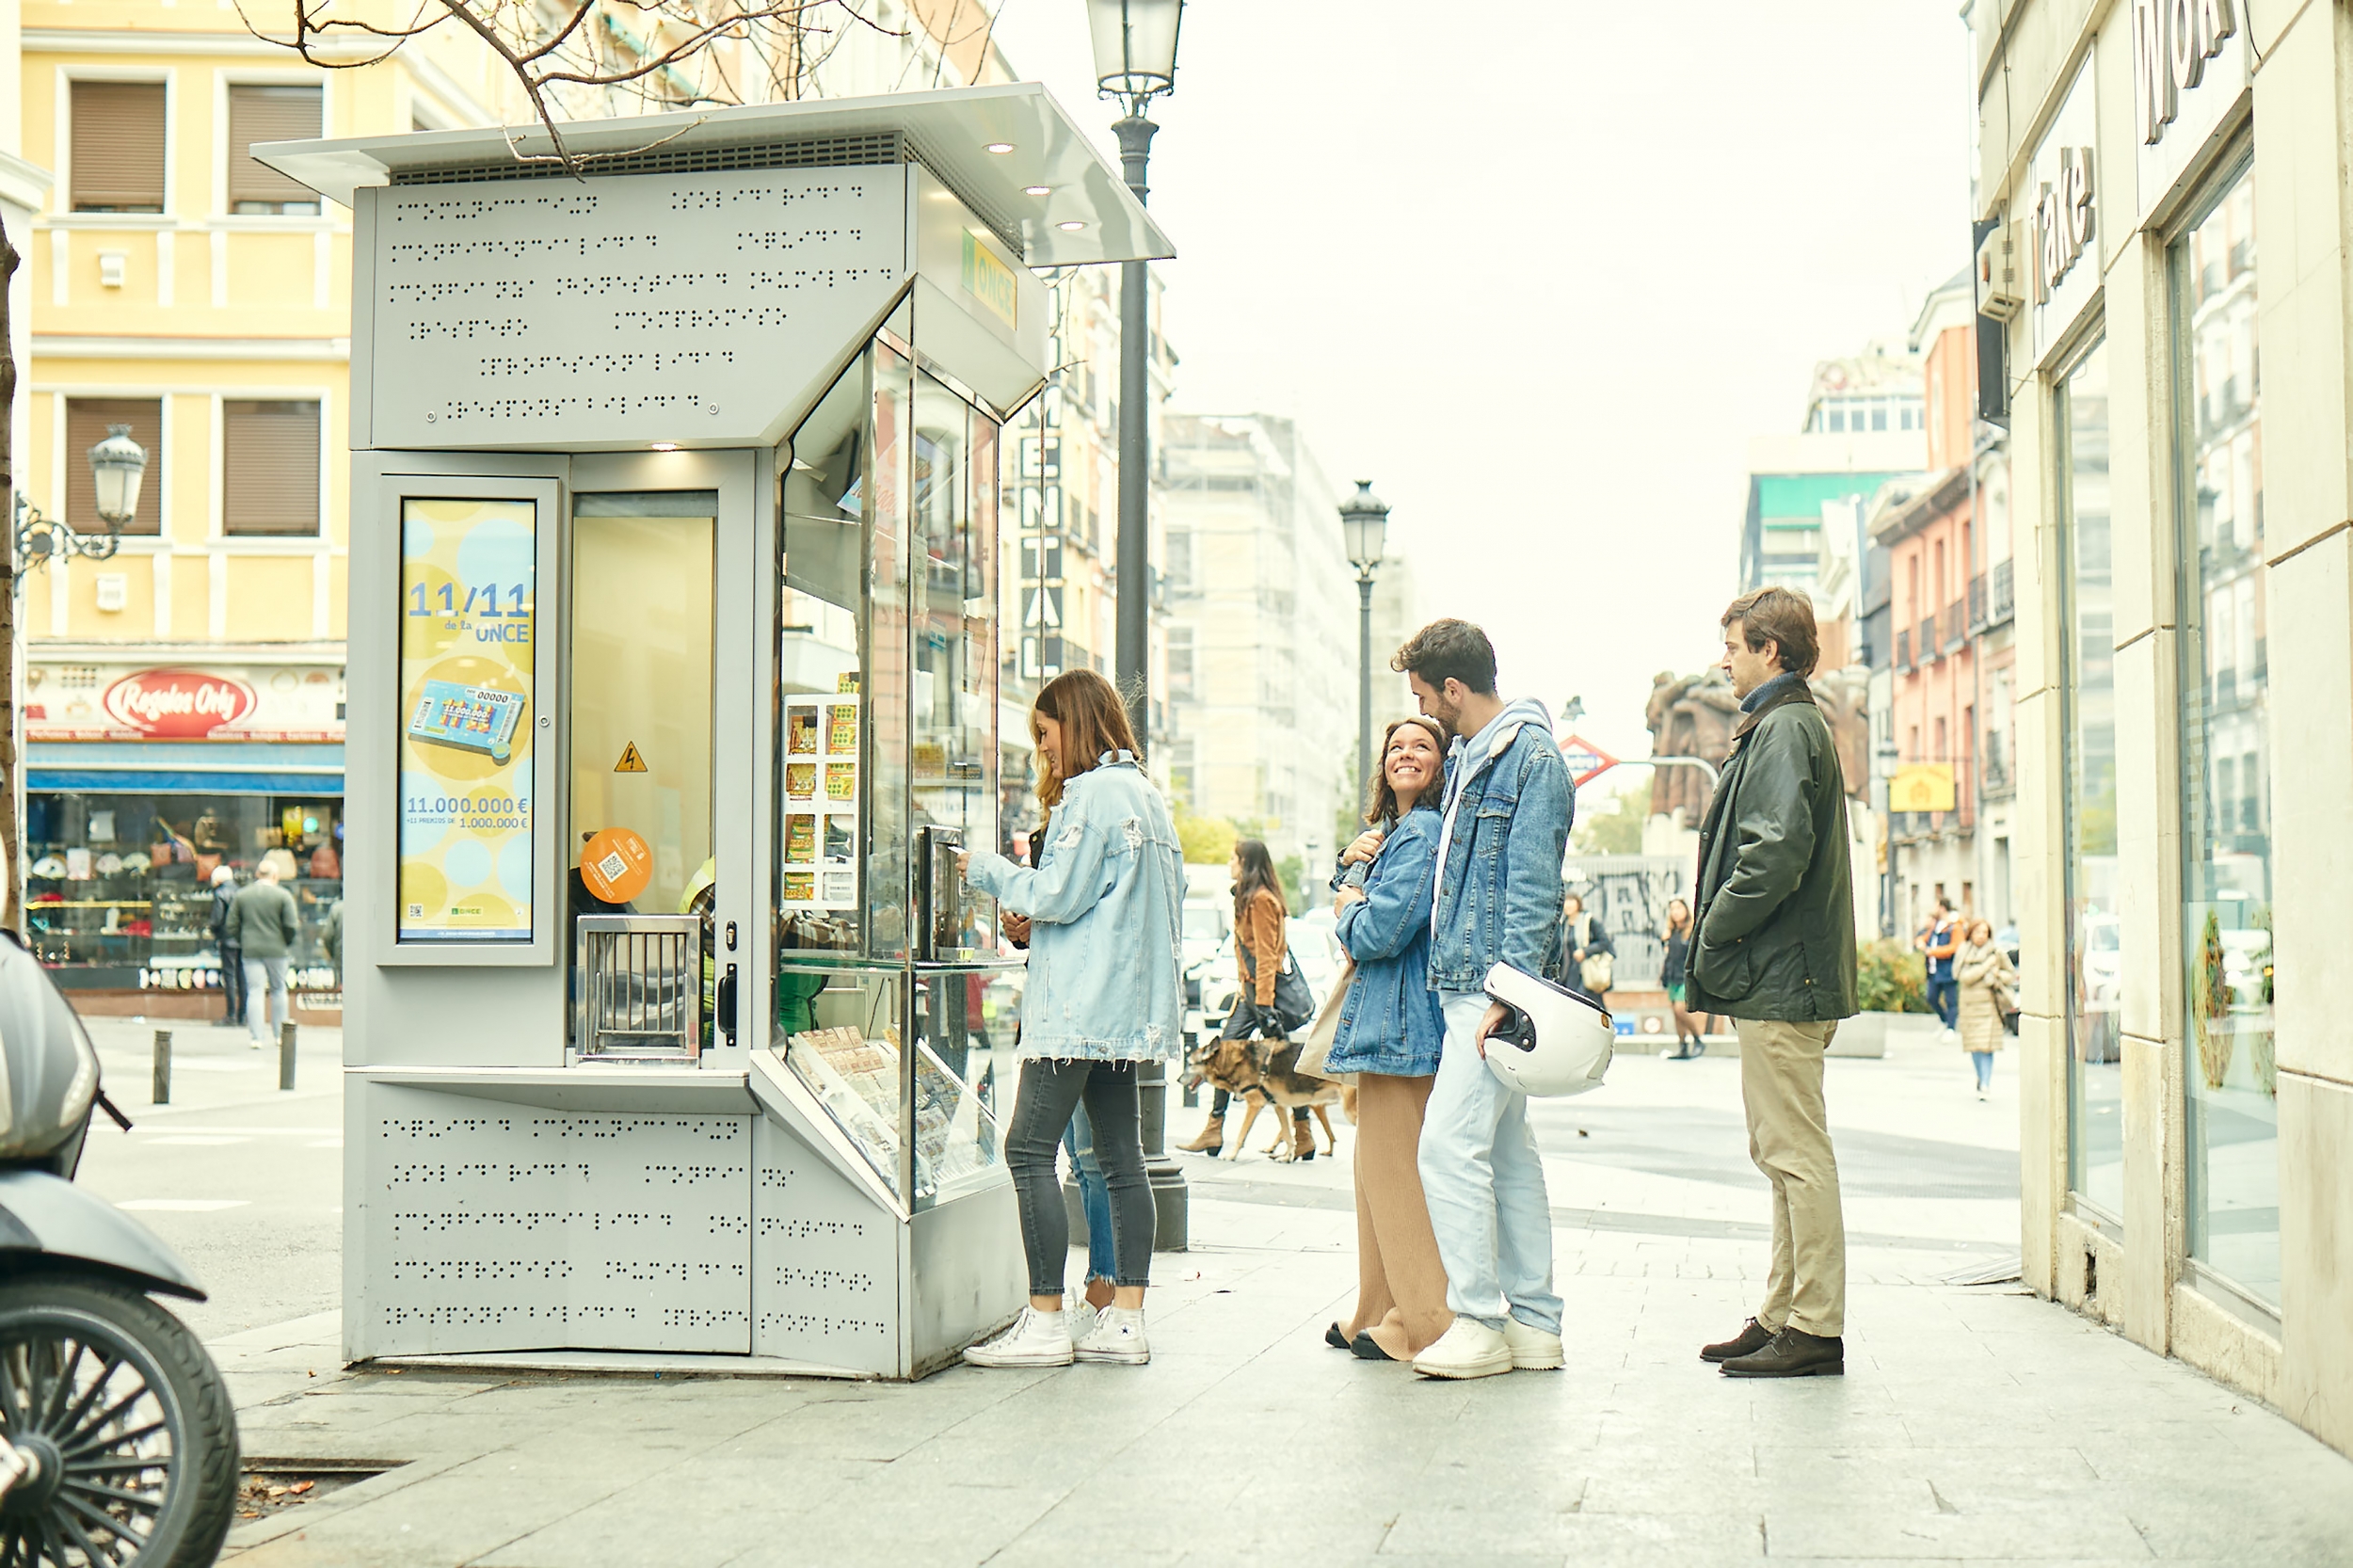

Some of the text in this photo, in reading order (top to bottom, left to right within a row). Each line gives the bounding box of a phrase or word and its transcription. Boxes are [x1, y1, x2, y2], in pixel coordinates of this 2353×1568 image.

[2028, 146, 2096, 308] Take
[979, 257, 1012, 316] ONCE
[408, 582, 529, 617] 11/11
[444, 620, 529, 643] de la ONCE
[121, 681, 236, 722] Regalos Orly
[477, 691, 509, 704] 00000
[408, 797, 528, 814] 11.000.000 €
[459, 817, 519, 828] 1.000.000
[520, 817, 528, 828] €
